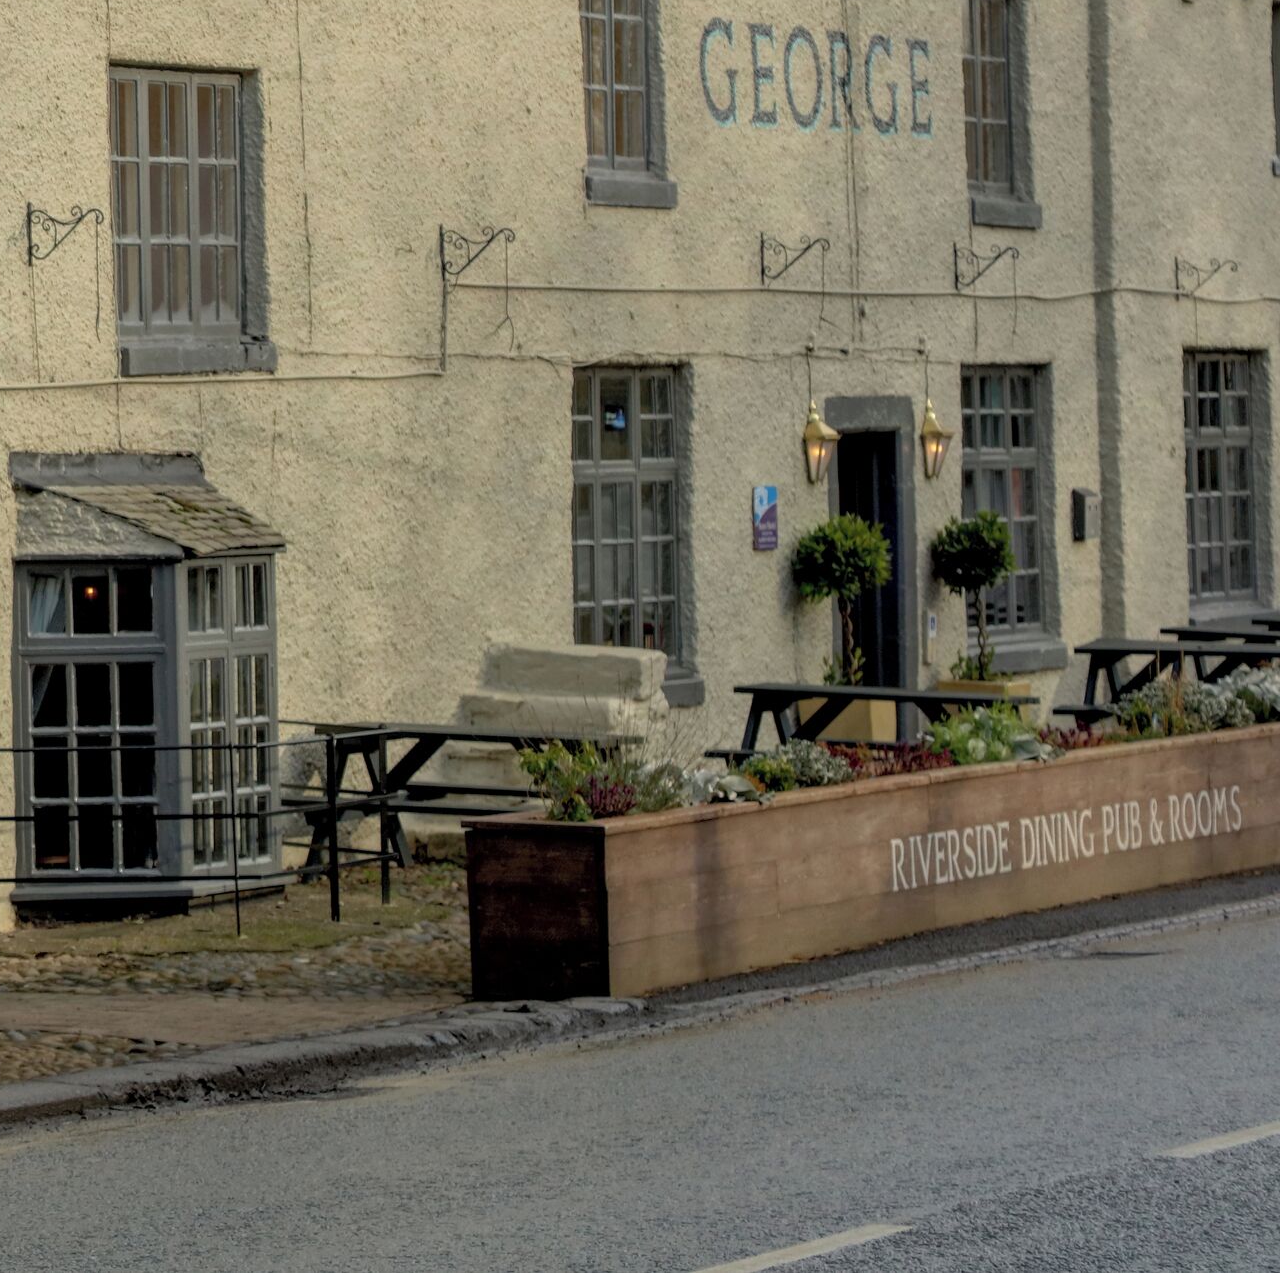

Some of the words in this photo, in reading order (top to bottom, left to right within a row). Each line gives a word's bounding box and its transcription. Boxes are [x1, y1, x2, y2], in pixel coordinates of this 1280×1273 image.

[699, 17, 934, 140] GEORGE
[890, 820, 1012, 892] RIVERSIDE
[1020, 807, 1095, 871] DINING
[1101, 800, 1142, 854] PUB
[1149, 798, 1165, 846] &
[1169, 785, 1242, 843] ROOMS
